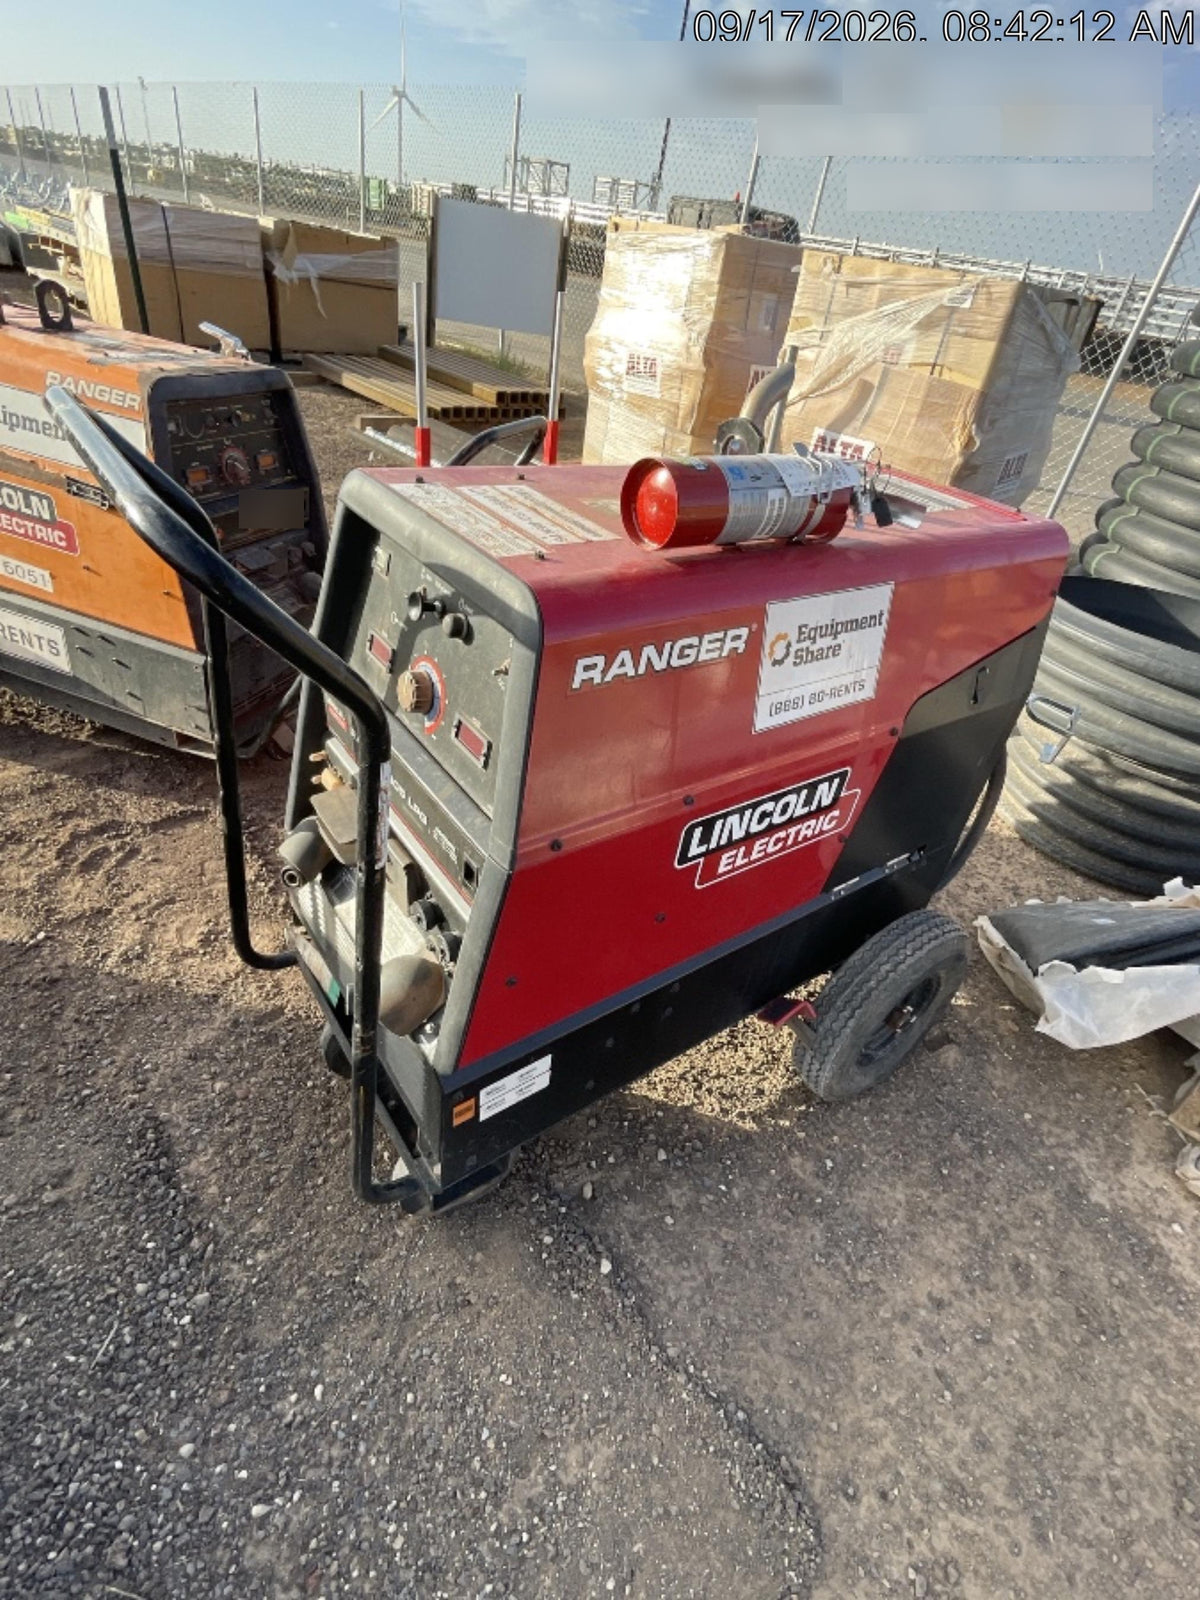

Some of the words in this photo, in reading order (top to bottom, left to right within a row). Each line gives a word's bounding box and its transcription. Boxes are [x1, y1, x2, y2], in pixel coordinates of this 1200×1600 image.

[45, 370, 141, 411] RANGER
[0, 487, 51, 520] OLN
[796, 609, 885, 645] Equipment
[571, 626, 749, 690] RANGER
[792, 642, 842, 668] Share
[686, 777, 841, 858] LINCOLN
[717, 808, 841, 875] ELECTRIC
